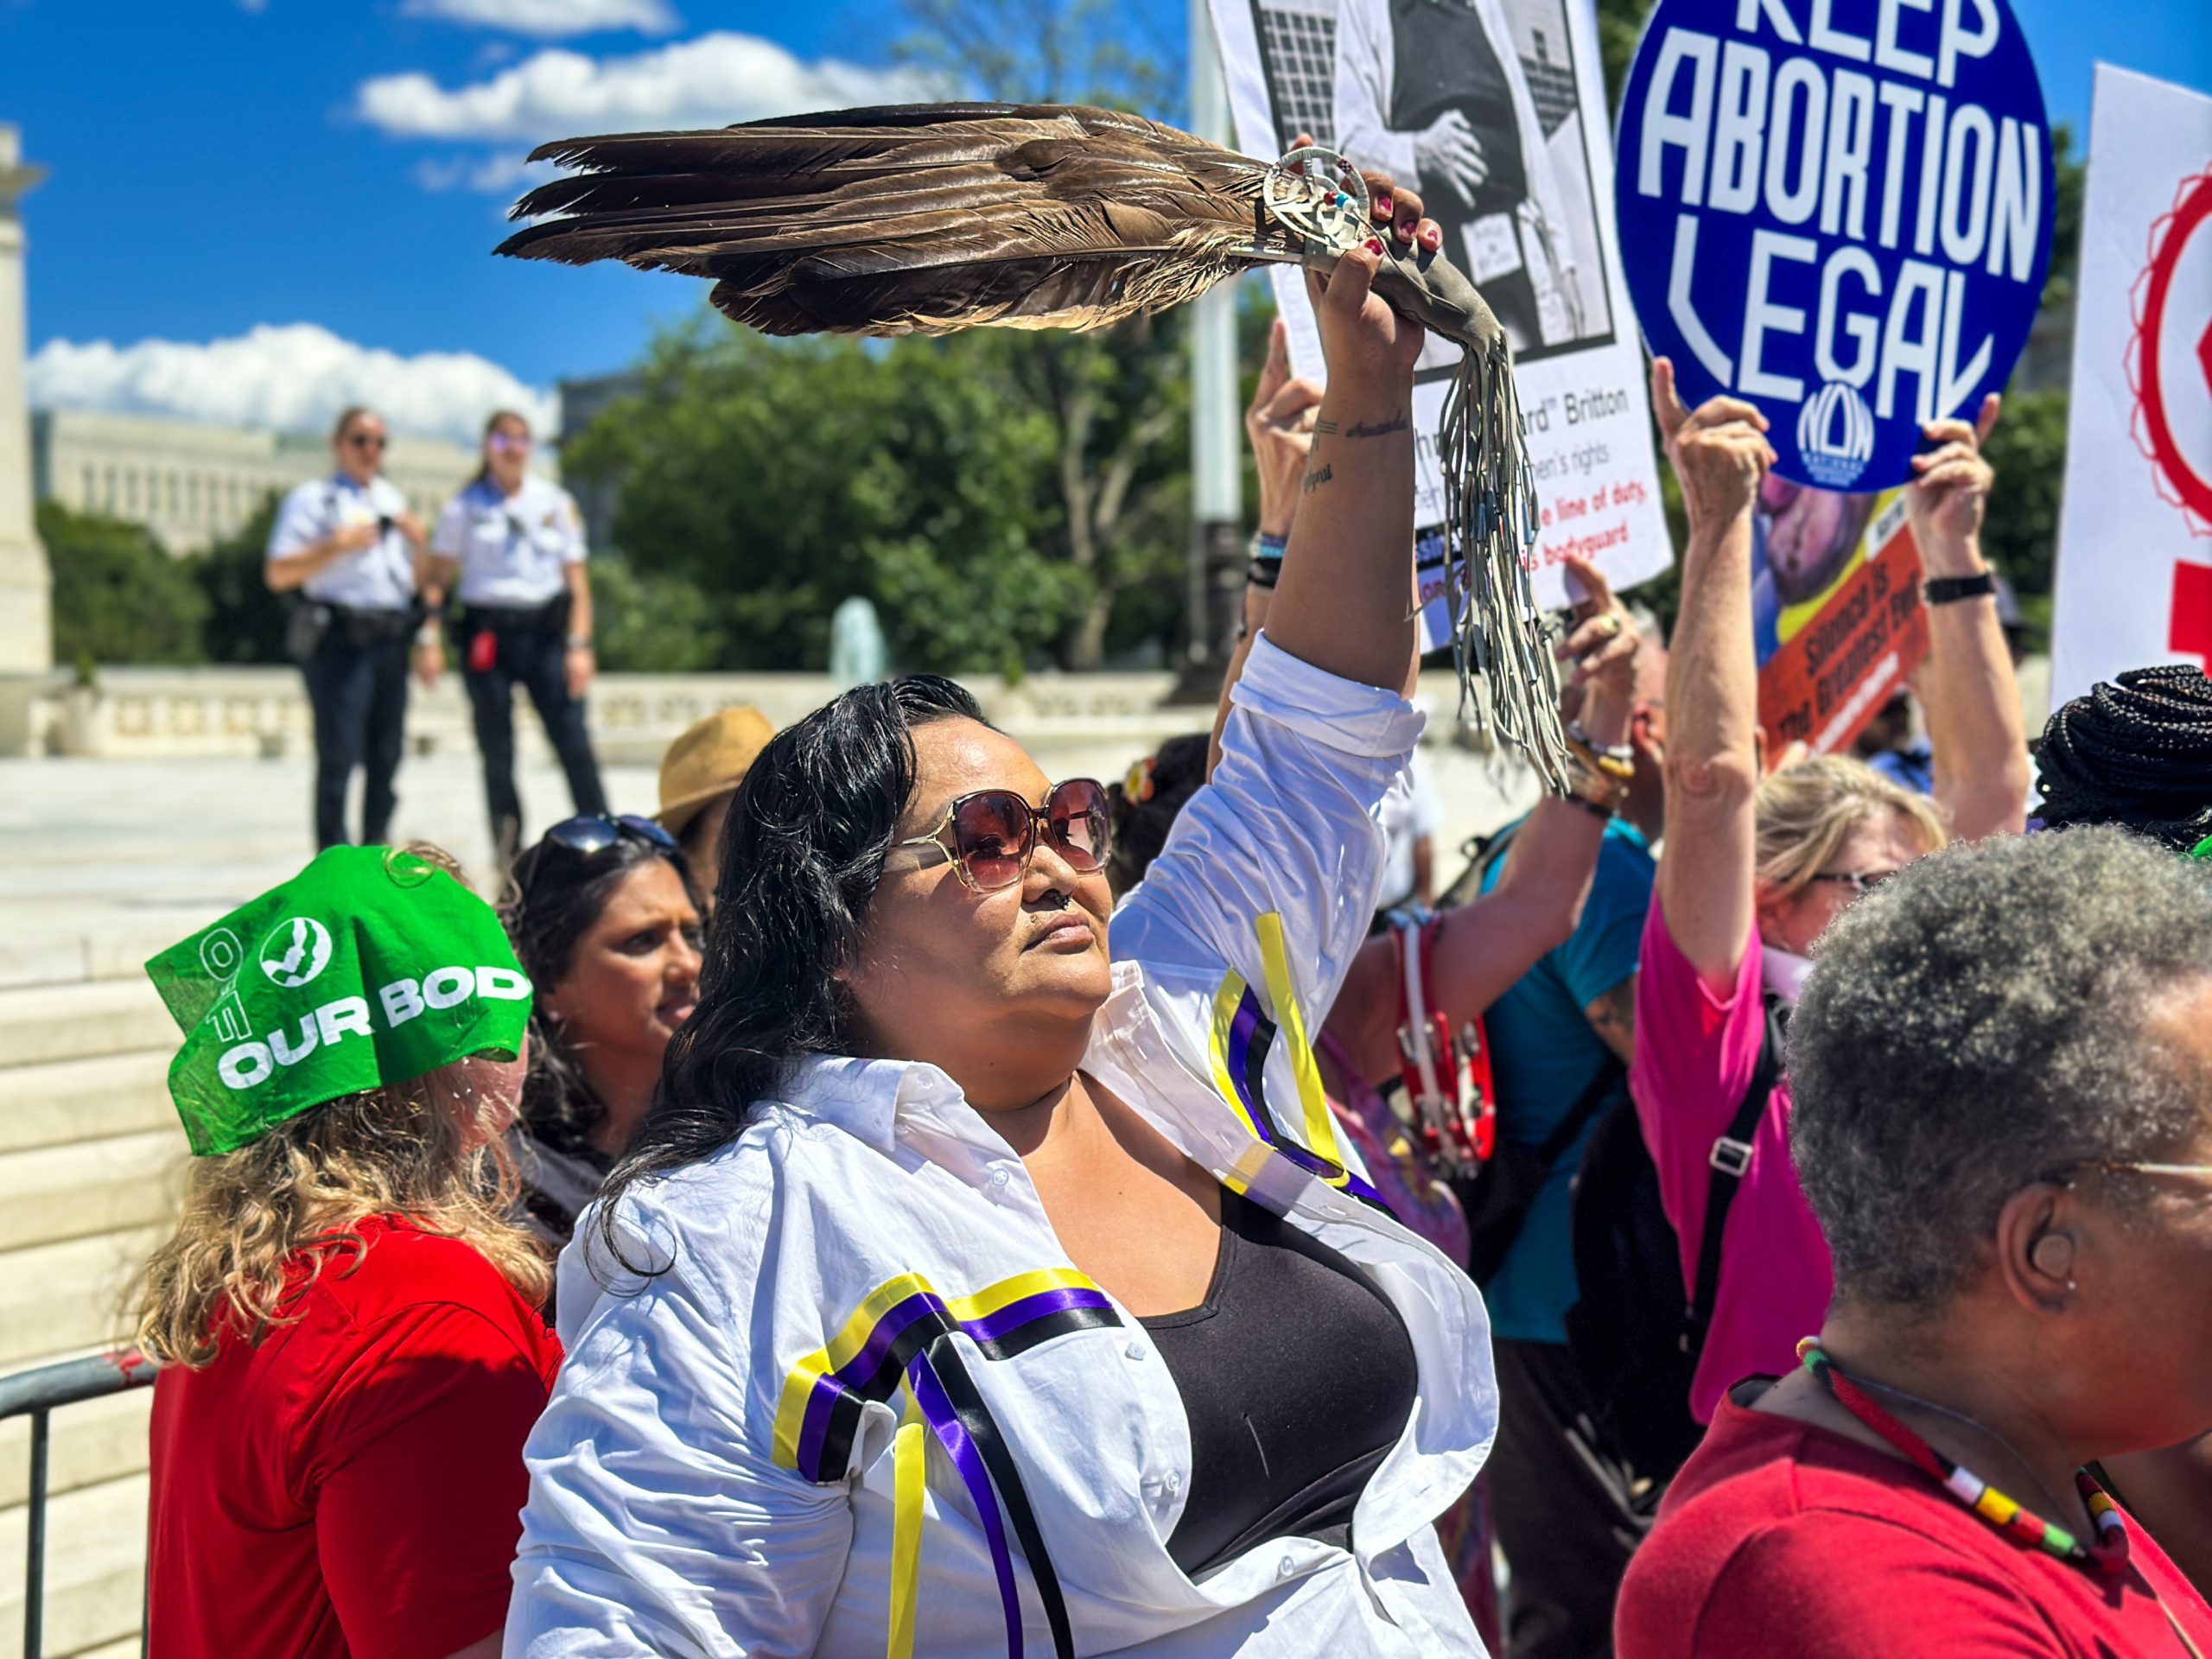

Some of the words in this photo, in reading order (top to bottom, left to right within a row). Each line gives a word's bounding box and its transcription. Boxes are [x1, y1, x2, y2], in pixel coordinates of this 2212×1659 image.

[1638, 27, 2041, 283] ABORTION
[1668, 213, 1993, 426] LEGAL
[1565, 388, 1629, 425] Britton
[1572, 442, 1610, 476] rights
[1555, 497, 1586, 522] line
[1592, 485, 1607, 512] of
[1542, 518, 1629, 566] bodyguard
[218, 995, 375, 1090] OUR
